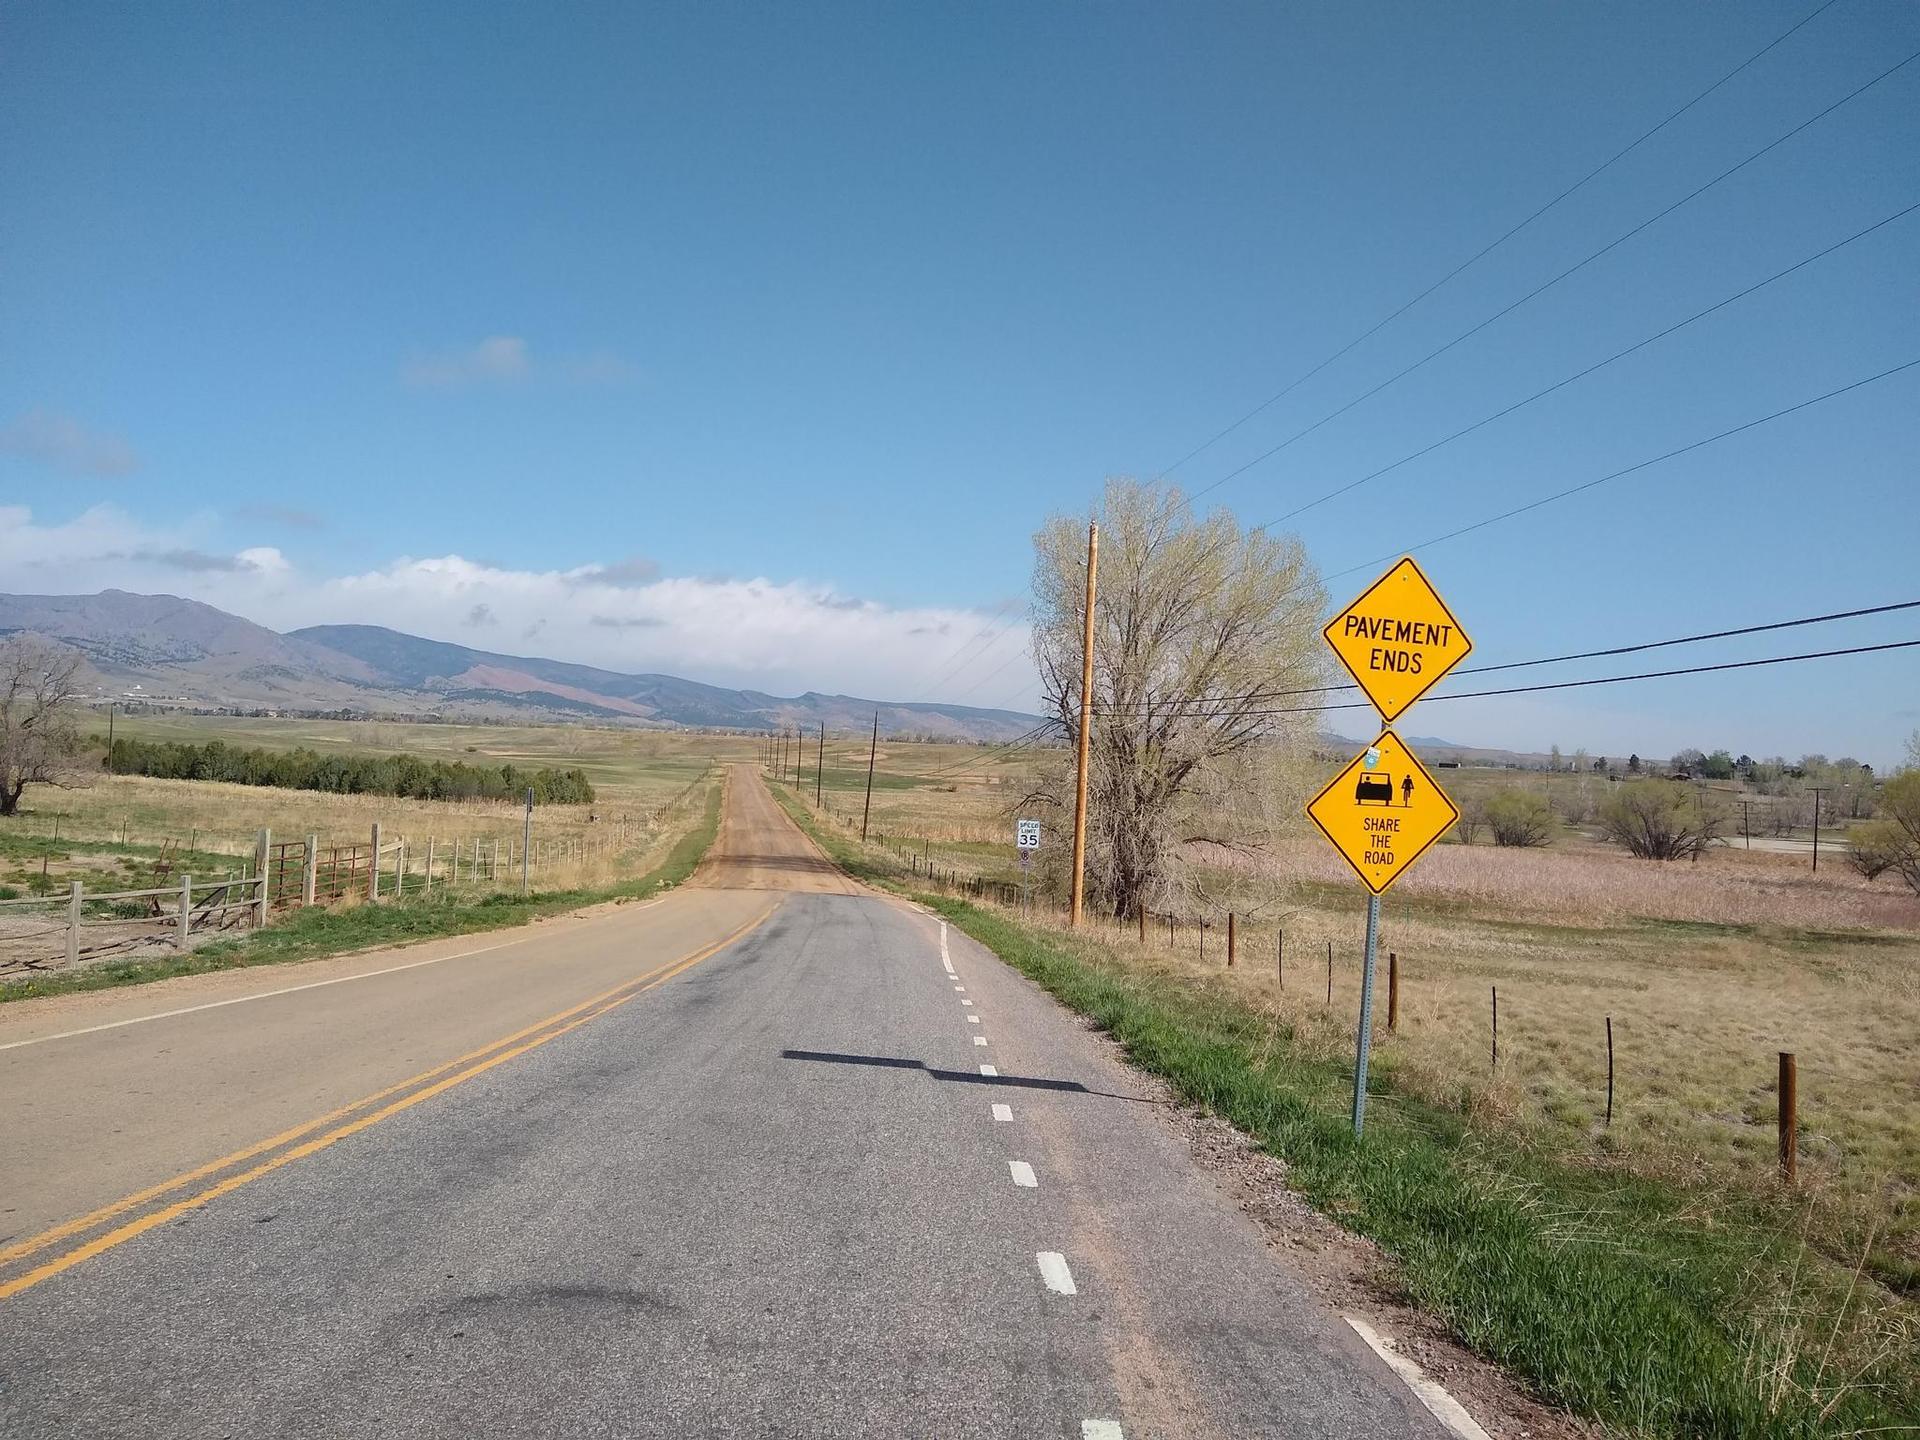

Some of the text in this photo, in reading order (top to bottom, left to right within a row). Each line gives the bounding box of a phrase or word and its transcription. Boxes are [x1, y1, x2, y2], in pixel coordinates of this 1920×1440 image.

[1345, 615, 1452, 647] PAVEMENT
[1370, 649, 1423, 674] ENDS
[1363, 818, 1401, 833] SHARE
[1020, 834, 1037, 846] 35
[1371, 834, 1391, 848] THE
[1364, 851, 1395, 865] ROAD
